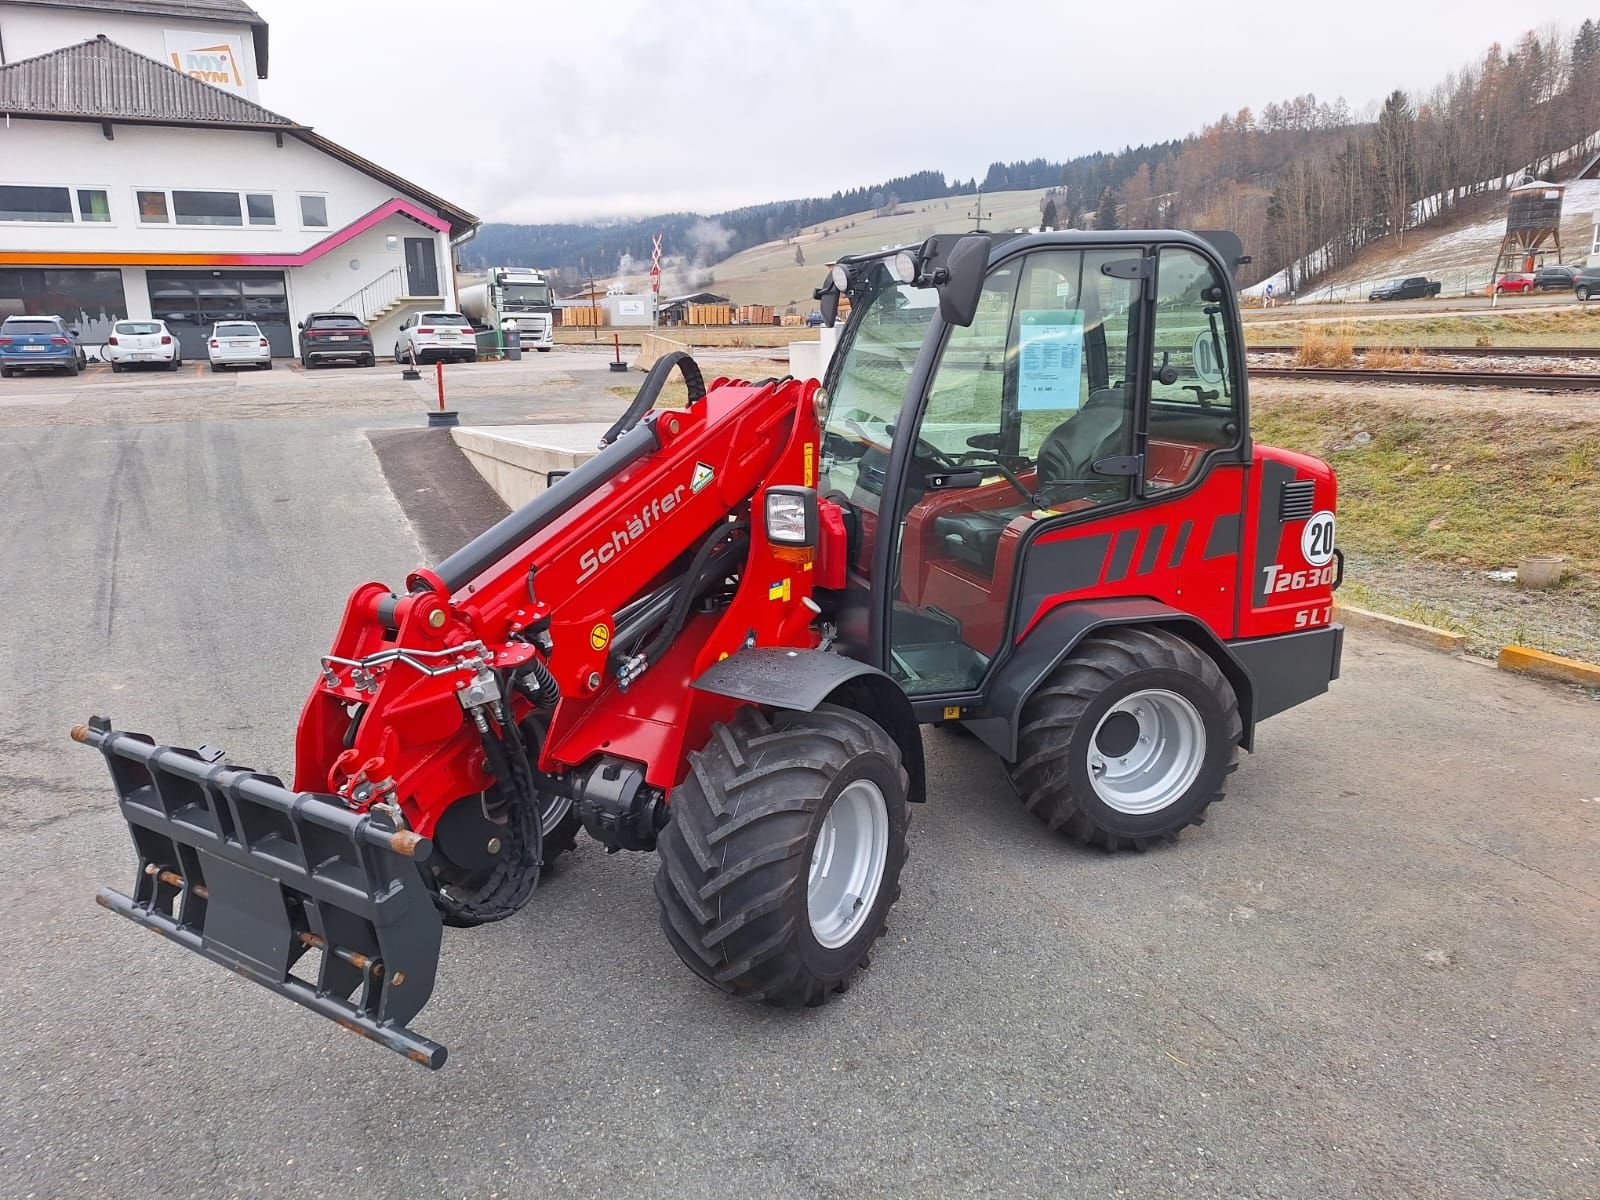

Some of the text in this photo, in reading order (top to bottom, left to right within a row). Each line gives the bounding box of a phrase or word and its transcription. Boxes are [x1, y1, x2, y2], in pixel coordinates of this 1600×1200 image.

[186, 54, 223, 71] MY
[576, 484, 685, 585] Schäffer
[1310, 521, 1333, 557] 20
[1262, 564, 1332, 595] T2630
